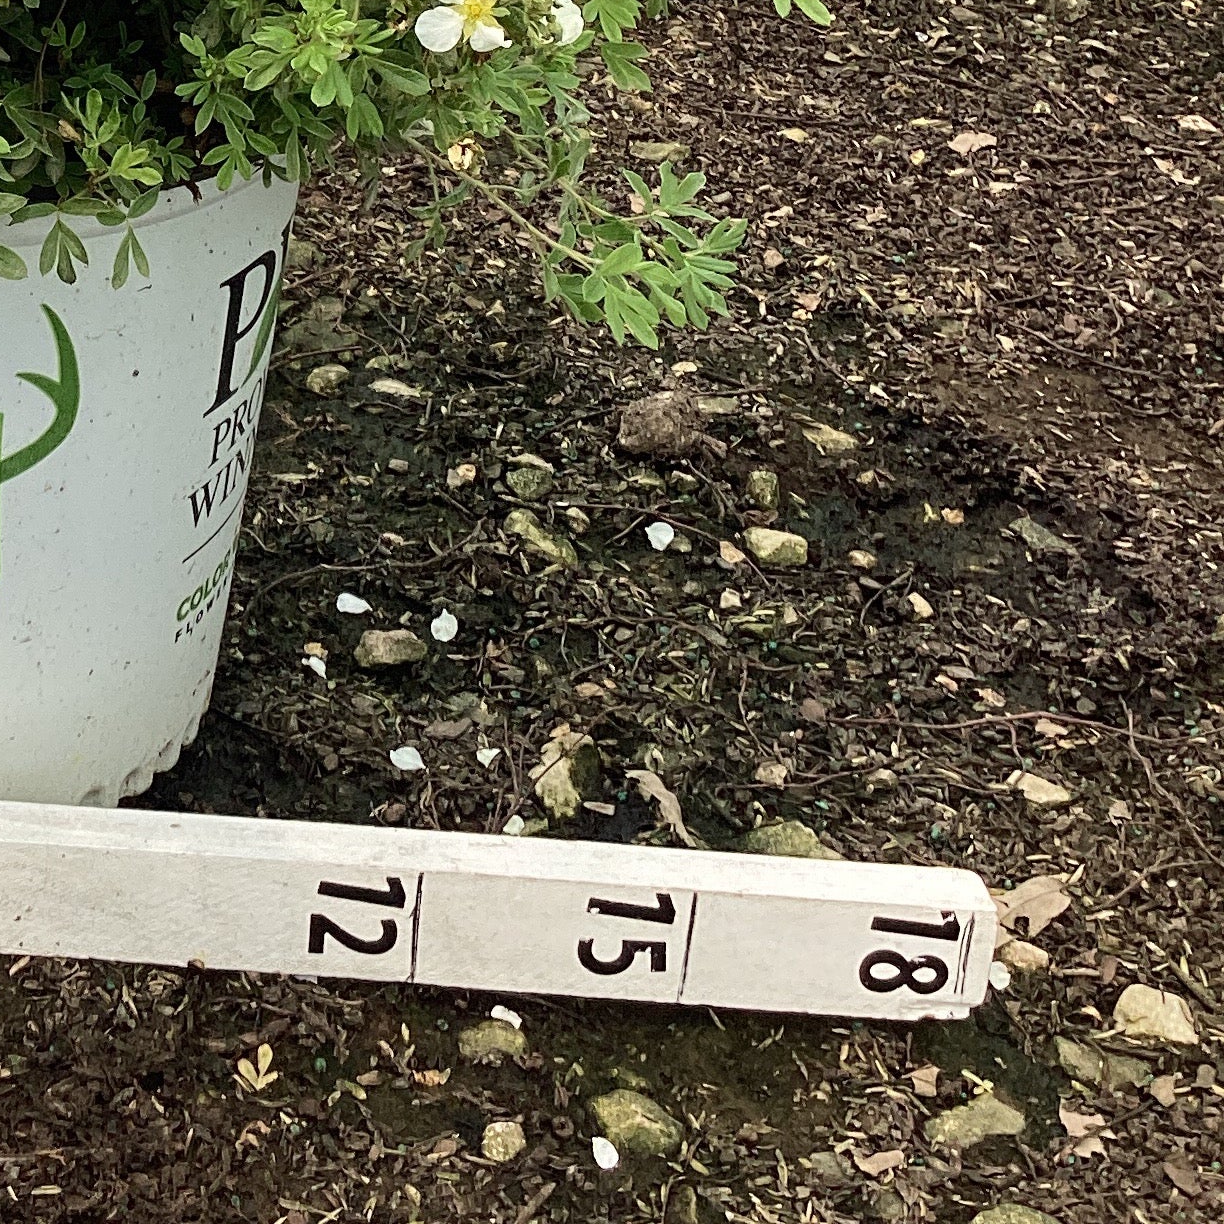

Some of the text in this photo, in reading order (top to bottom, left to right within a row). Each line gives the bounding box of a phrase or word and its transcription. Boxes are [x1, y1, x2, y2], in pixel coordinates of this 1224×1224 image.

[308, 876, 407, 954] 12
[577, 892, 677, 976] 15
[859, 909, 961, 995] 18
